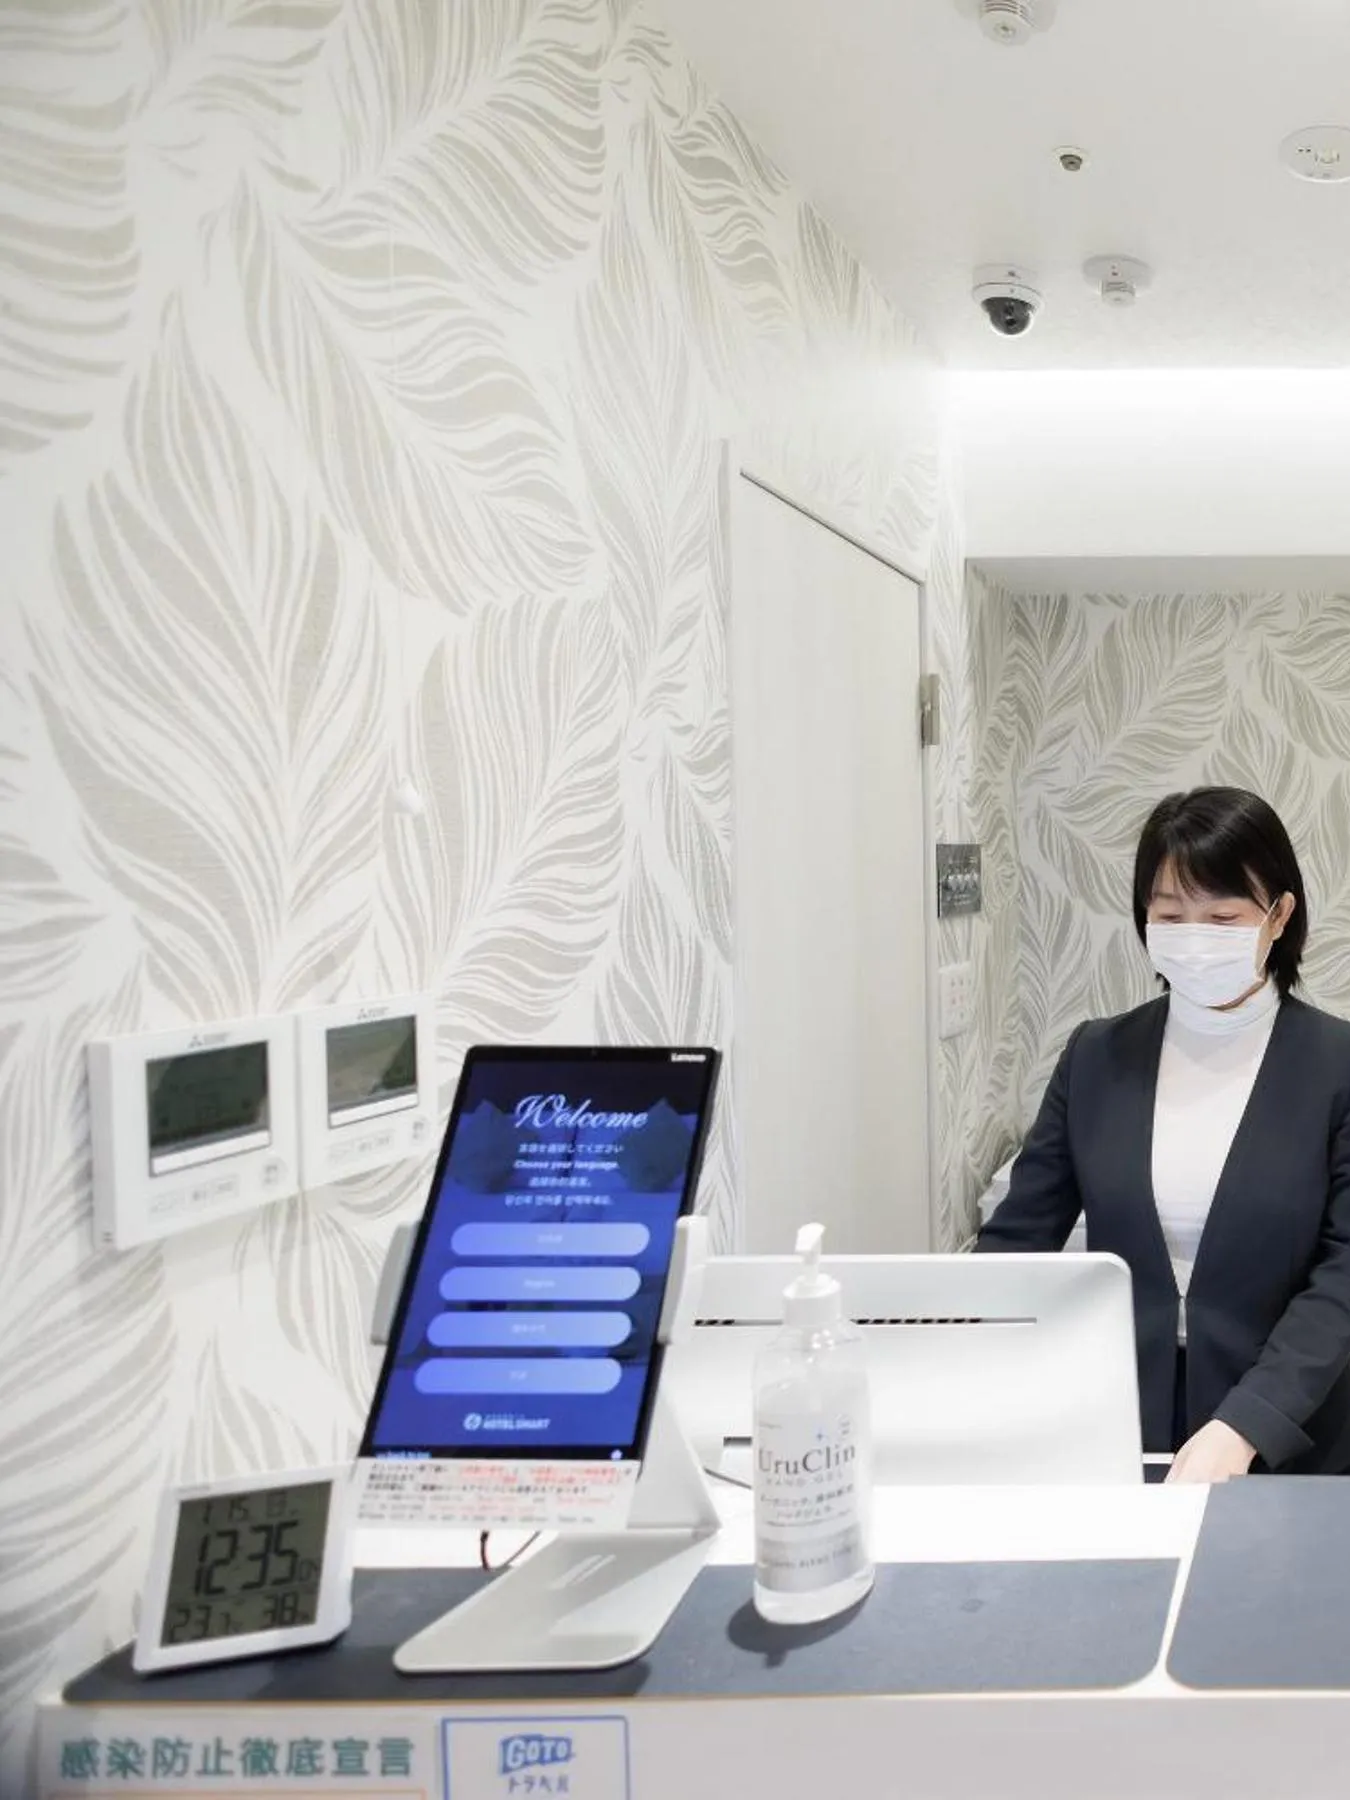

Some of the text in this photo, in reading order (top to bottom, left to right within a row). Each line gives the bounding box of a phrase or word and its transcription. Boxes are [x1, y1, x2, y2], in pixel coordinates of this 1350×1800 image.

[513, 1094, 649, 1129] Welcome
[758, 1444, 856, 1475] UruClin
[59, 1736, 415, 1780] 感染防止徹底宣言
